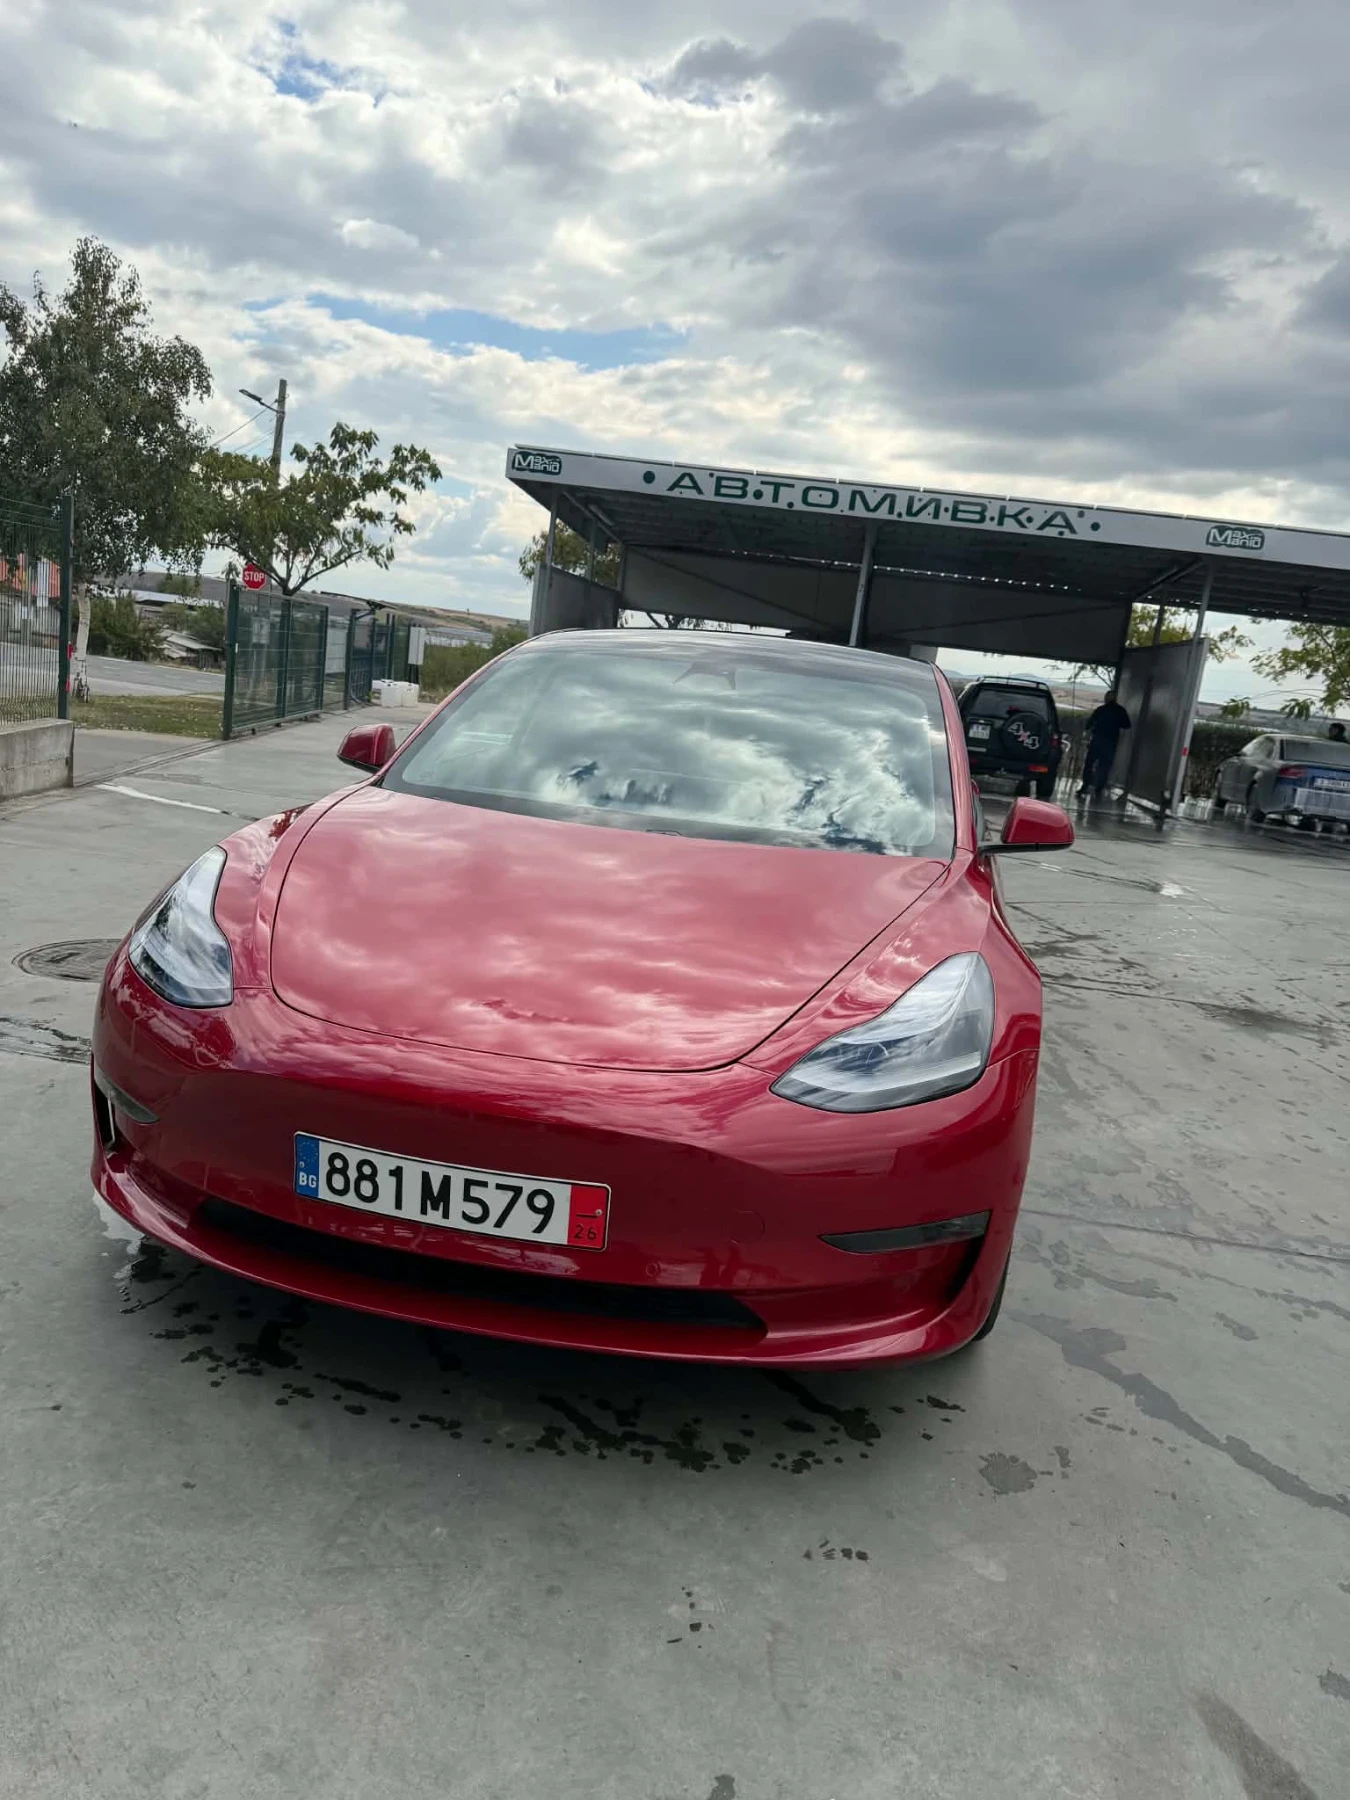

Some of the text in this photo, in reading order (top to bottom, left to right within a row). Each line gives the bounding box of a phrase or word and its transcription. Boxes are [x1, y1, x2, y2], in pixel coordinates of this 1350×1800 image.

[667, 472, 1078, 535] АВТОМИВКА
[244, 571, 265, 583] STOP
[299, 1171, 317, 1188] BG
[574, 1223, 597, 1241] 26
